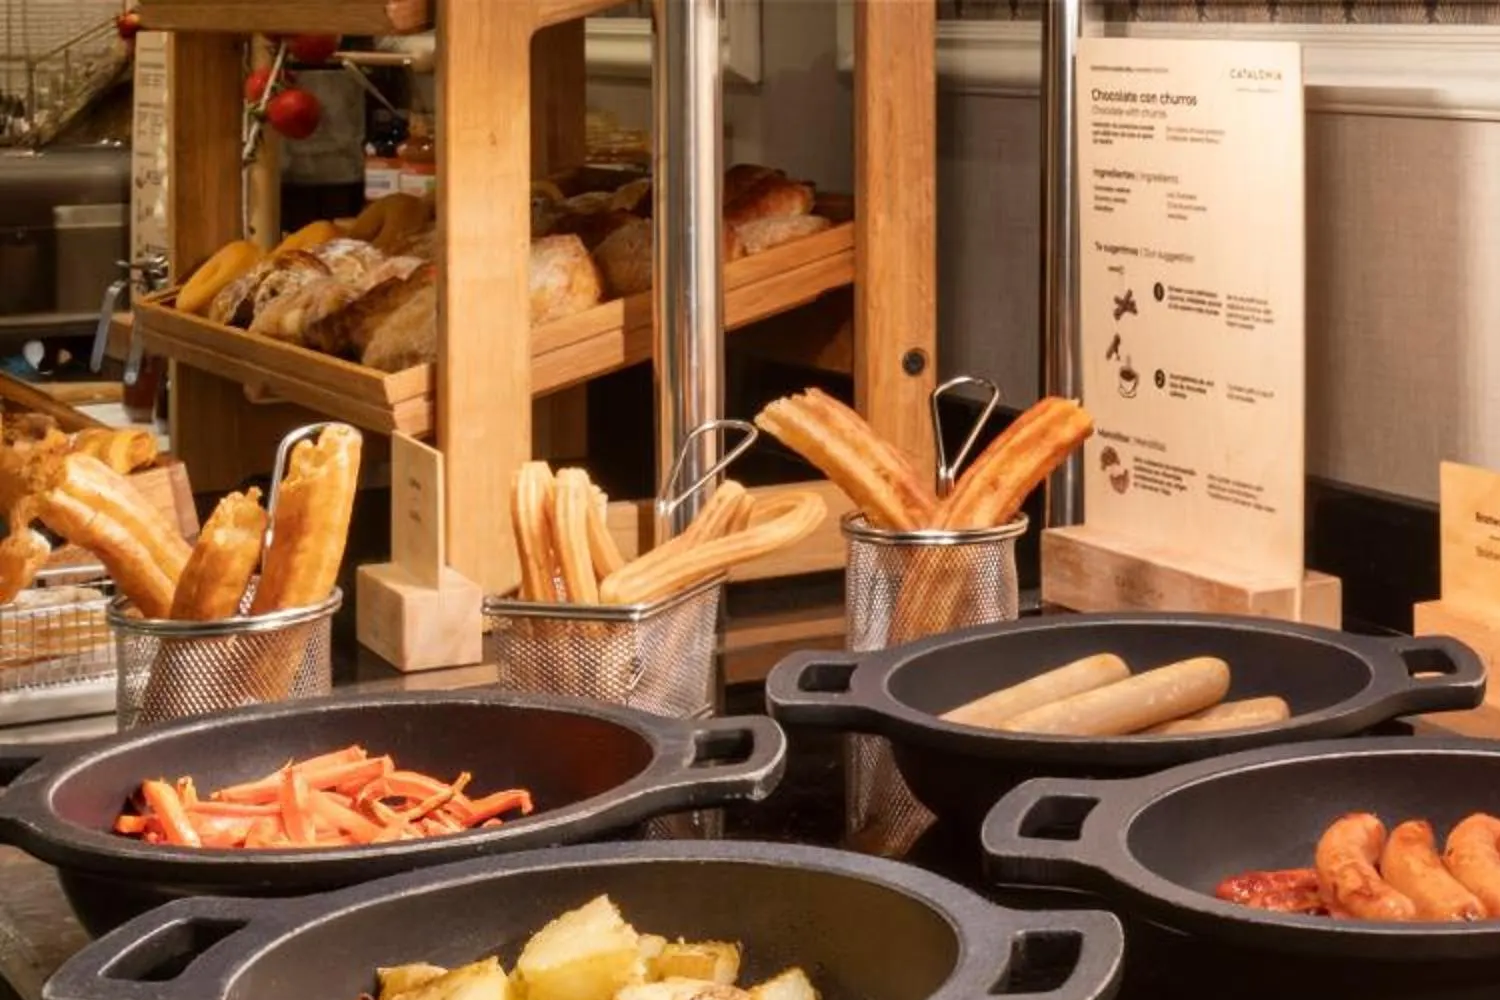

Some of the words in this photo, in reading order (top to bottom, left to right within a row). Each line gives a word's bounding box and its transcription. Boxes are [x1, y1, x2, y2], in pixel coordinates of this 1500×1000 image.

[1091, 88, 1137, 103] Chocolate
[1139, 91, 1157, 103] con
[1159, 91, 1198, 106] churros
